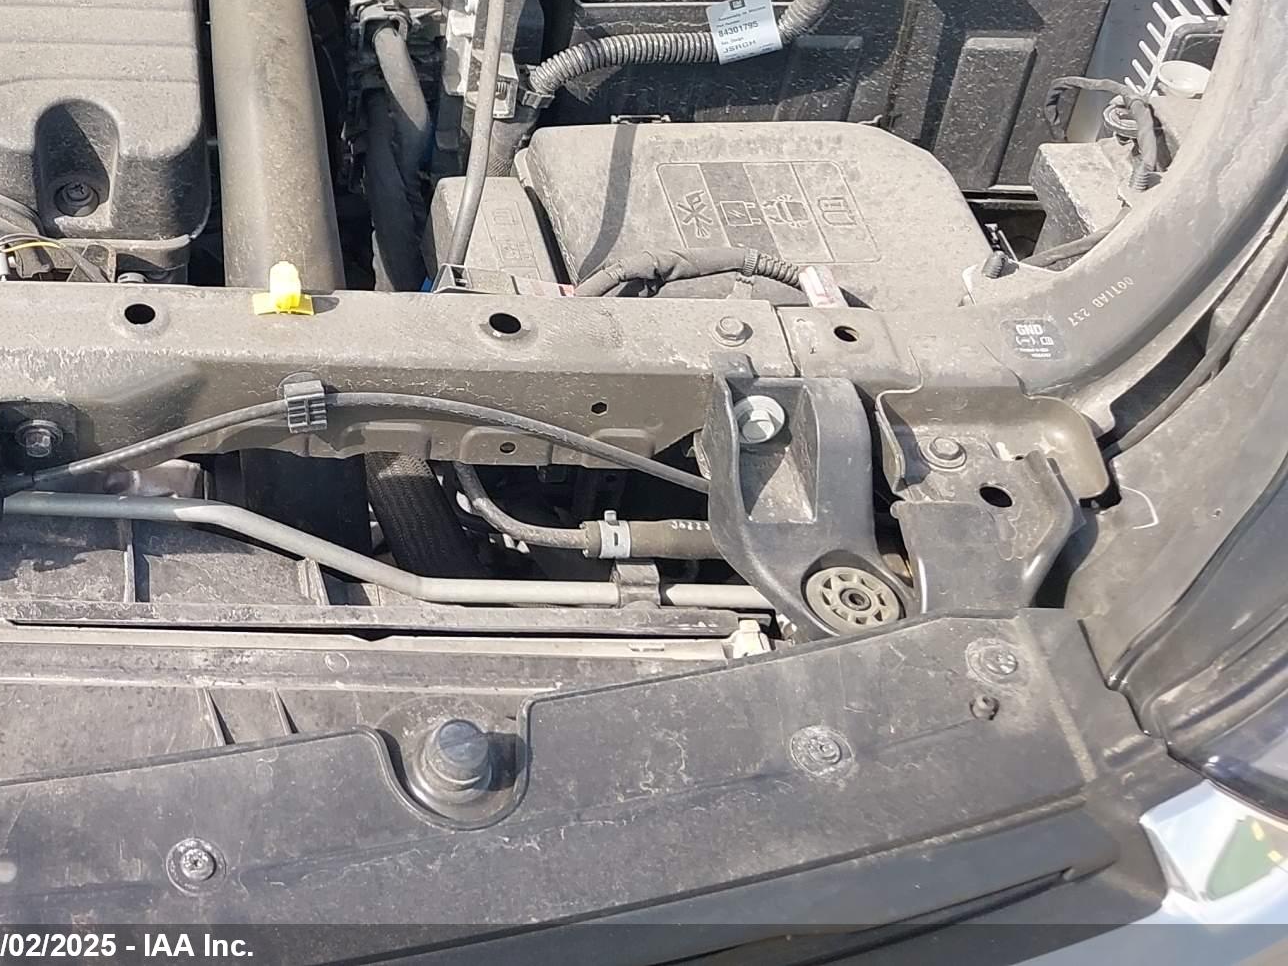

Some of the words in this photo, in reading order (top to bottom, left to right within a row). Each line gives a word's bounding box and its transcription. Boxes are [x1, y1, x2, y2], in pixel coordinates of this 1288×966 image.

[718, 21, 759, 37] 84301795
[1067, 307, 1090, 326] 237
[1015, 324, 1043, 335] GND
